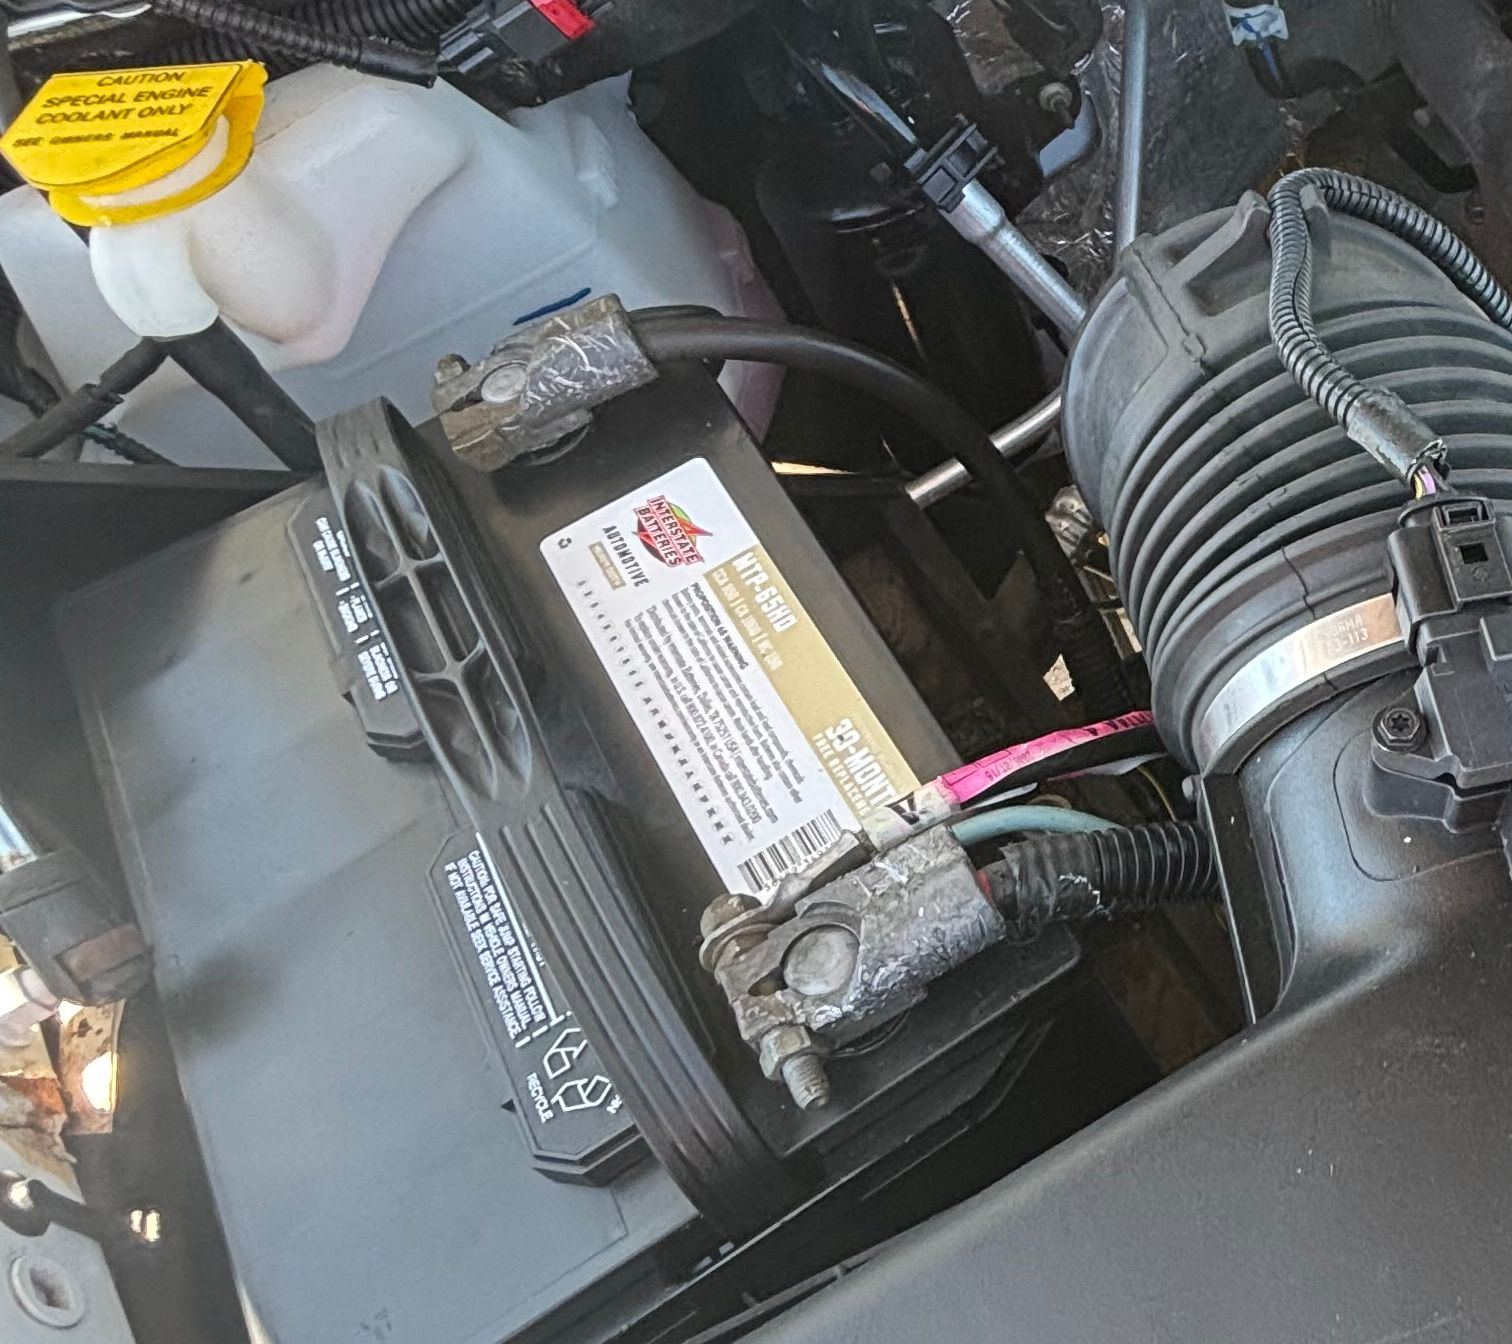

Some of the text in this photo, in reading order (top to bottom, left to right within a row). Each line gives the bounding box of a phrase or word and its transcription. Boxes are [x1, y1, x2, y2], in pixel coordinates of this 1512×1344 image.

[42, 86, 213, 109] SPECIAL ENGINE
[97, 72, 188, 87] CAUTION
[35, 103, 193, 125] COOLANT ONLY
[601, 523, 650, 588] AUTOMOTIVE
[636, 505, 683, 566] BATTERIES
[649, 496, 700, 563] INTERSTATE
[730, 550, 798, 633] MTP-65HD
[453, 888, 480, 931] AVAILABLE
[477, 949, 502, 987] SERVICE
[523, 1071, 555, 1124] RECYCLE
